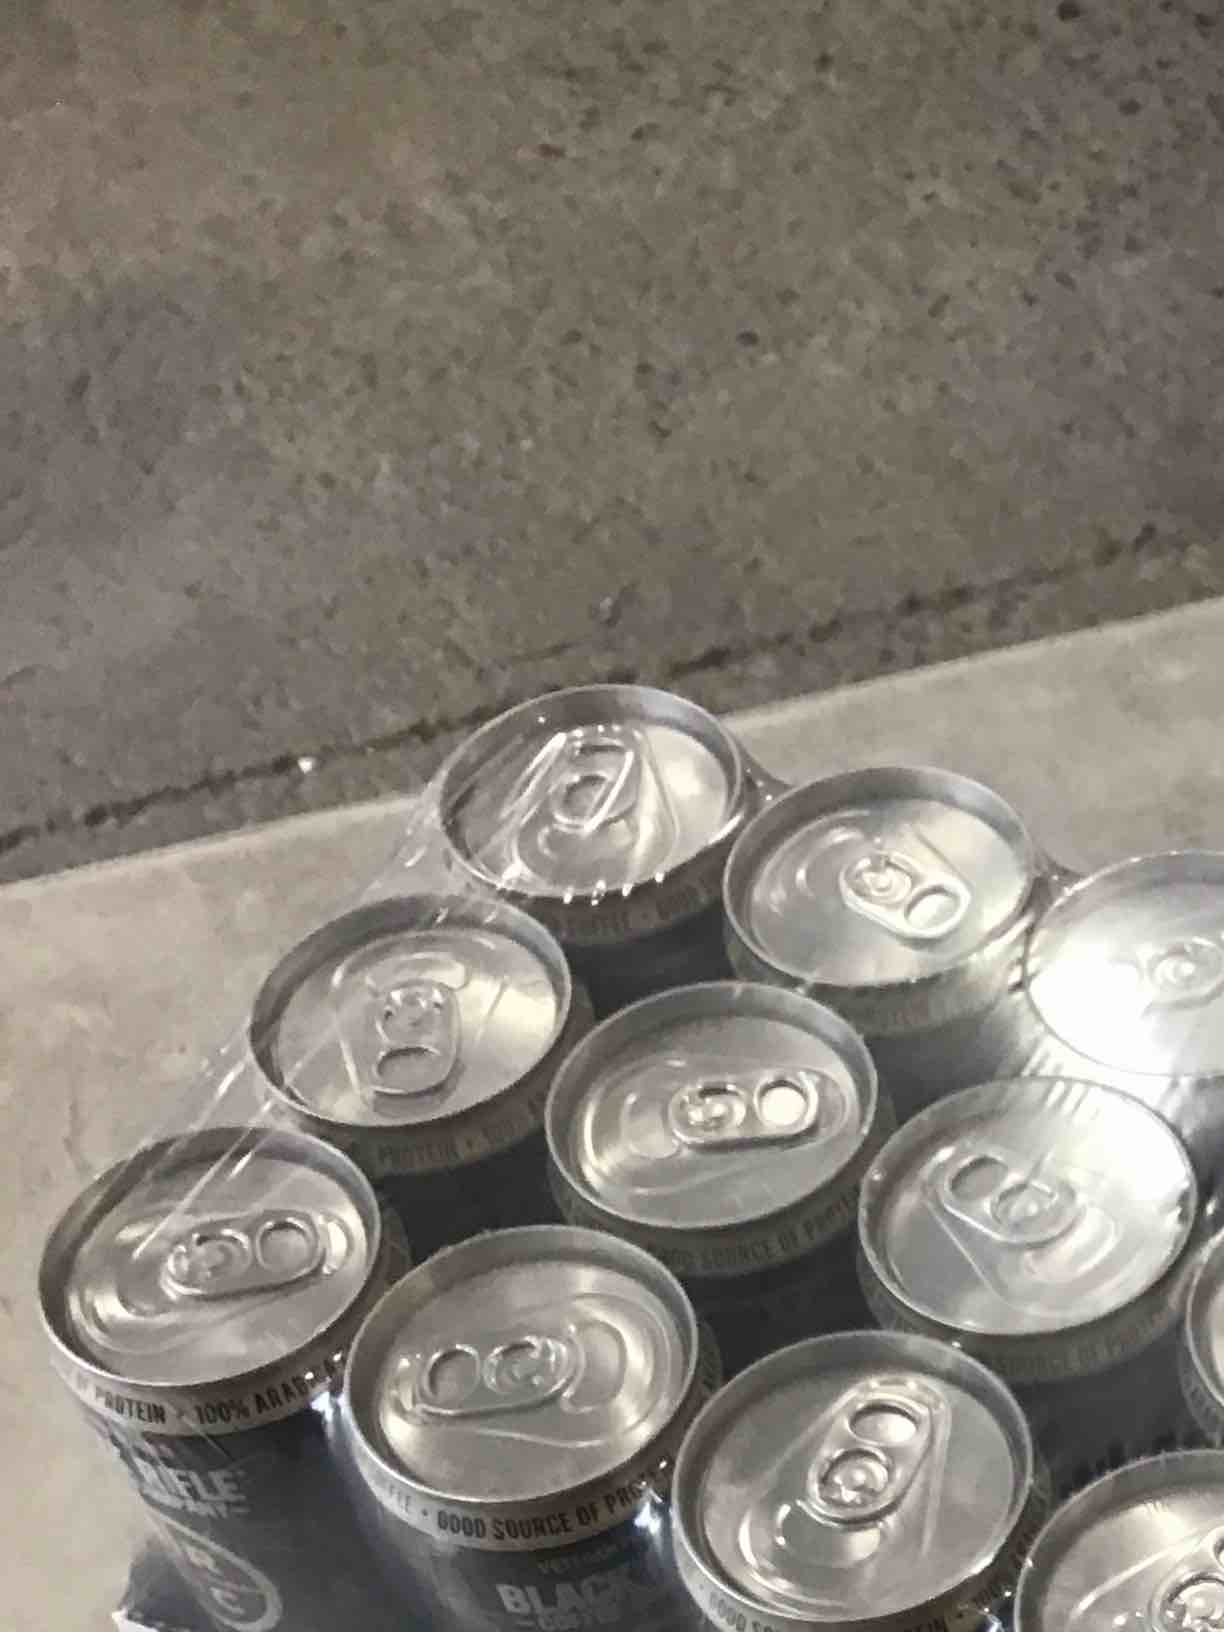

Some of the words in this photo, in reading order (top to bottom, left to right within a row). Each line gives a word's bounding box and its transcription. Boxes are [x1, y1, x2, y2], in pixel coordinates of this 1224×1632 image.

[436, 1509, 486, 1539] GOOD
[491, 1511, 574, 1541] SOURCE
[576, 1496, 600, 1527] OF
